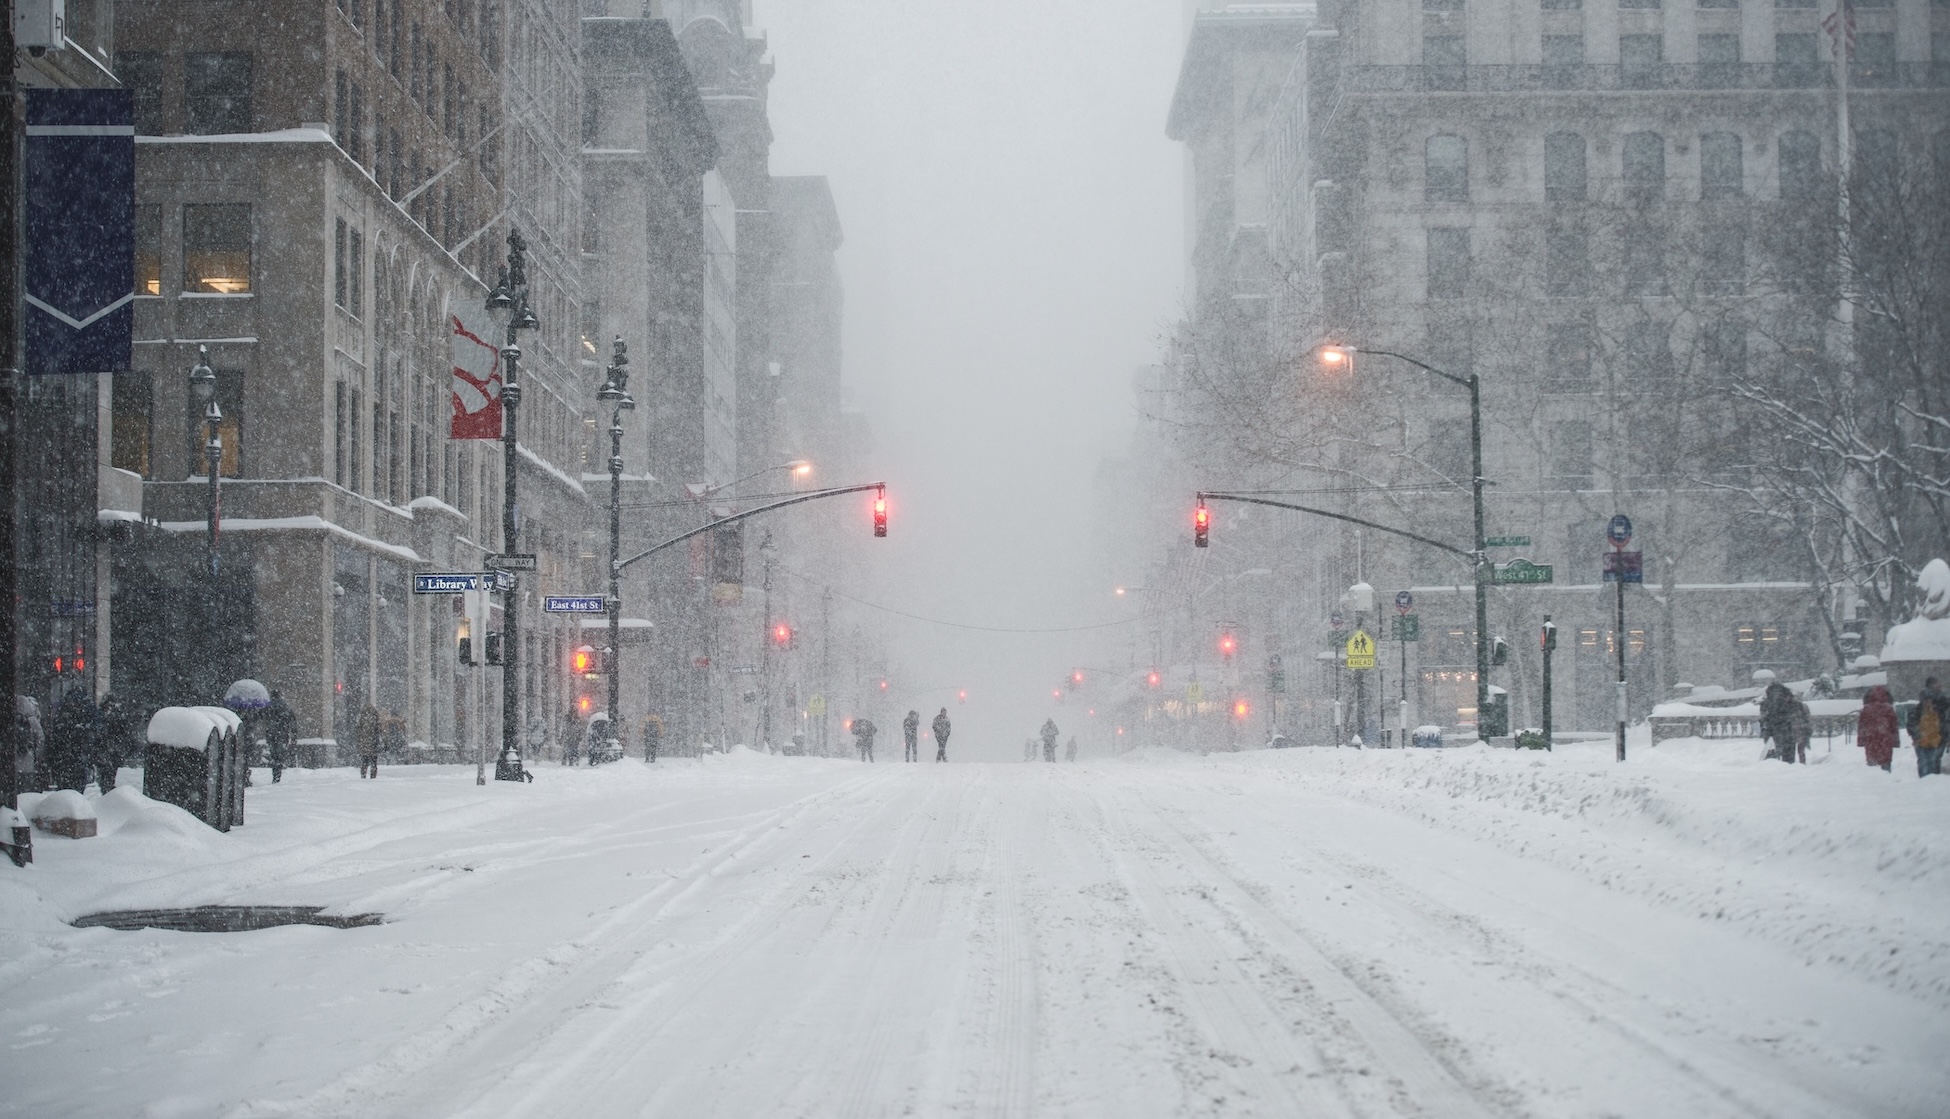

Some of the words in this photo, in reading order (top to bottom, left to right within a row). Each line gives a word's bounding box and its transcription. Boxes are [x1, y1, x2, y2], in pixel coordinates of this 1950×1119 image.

[1495, 570, 1516, 580] West
[1537, 570, 1547, 579] St
[427, 579, 467, 591] Library
[551, 600, 569, 609] East
[571, 600, 588, 609] 41st
[589, 600, 599, 609] St
